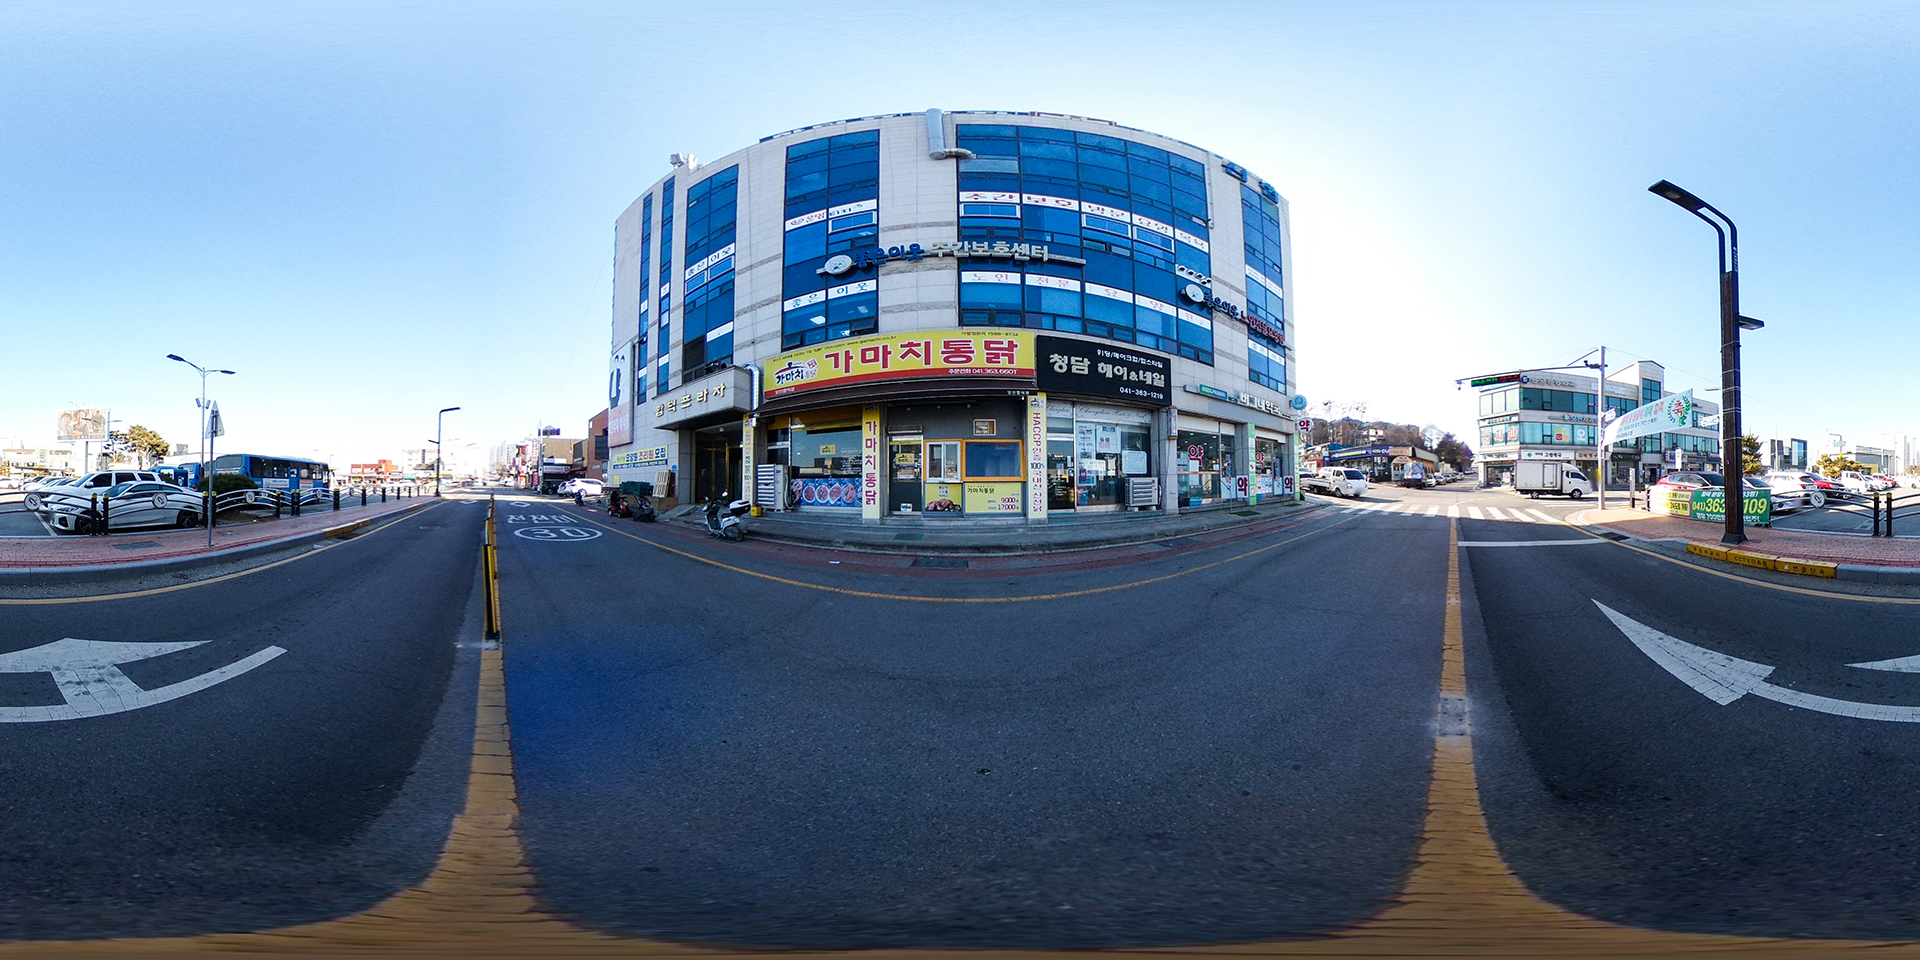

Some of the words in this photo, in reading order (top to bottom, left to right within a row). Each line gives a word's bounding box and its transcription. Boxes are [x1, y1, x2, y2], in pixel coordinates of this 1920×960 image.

[931, 241, 1050, 262] 주간보호센터
[824, 339, 1019, 374] 가마치통닭
[775, 368, 804, 386] 가마치
[1049, 353, 1091, 375] 청담
[1097, 361, 1165, 388] 헤어&네일
[1119, 386, 1164, 400] 041-363-1219
[1298, 419, 1311, 432] 약
[864, 420, 878, 506] 가마치통닭
[1188, 445, 1204, 466] 약
[1237, 477, 1248, 497] 약
[1284, 476, 1294, 493] 약
[530, 528, 591, 539] 30
